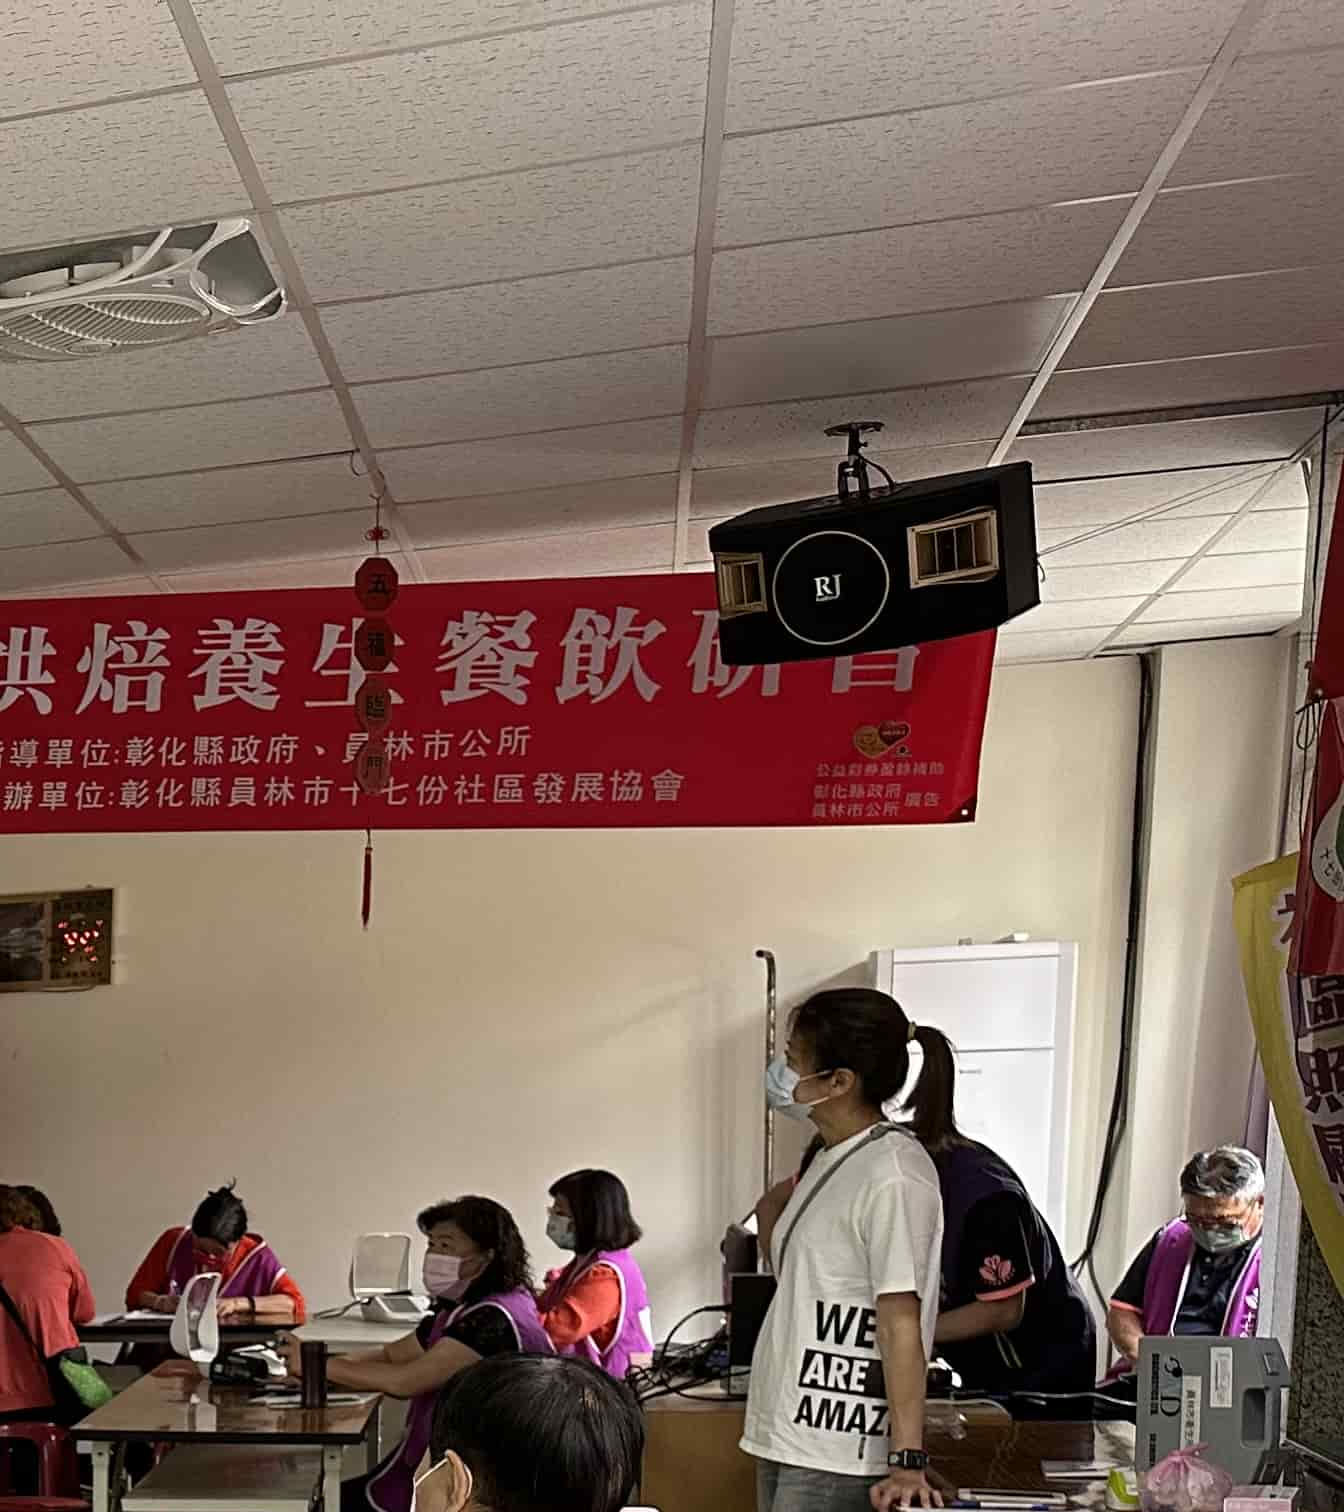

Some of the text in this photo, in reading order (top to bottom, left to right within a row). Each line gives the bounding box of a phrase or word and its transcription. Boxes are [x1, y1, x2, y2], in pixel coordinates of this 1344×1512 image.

[816, 1300, 877, 1348] WE
[802, 1353, 870, 1392] ARE
[793, 1395, 892, 1437] AMAZ
